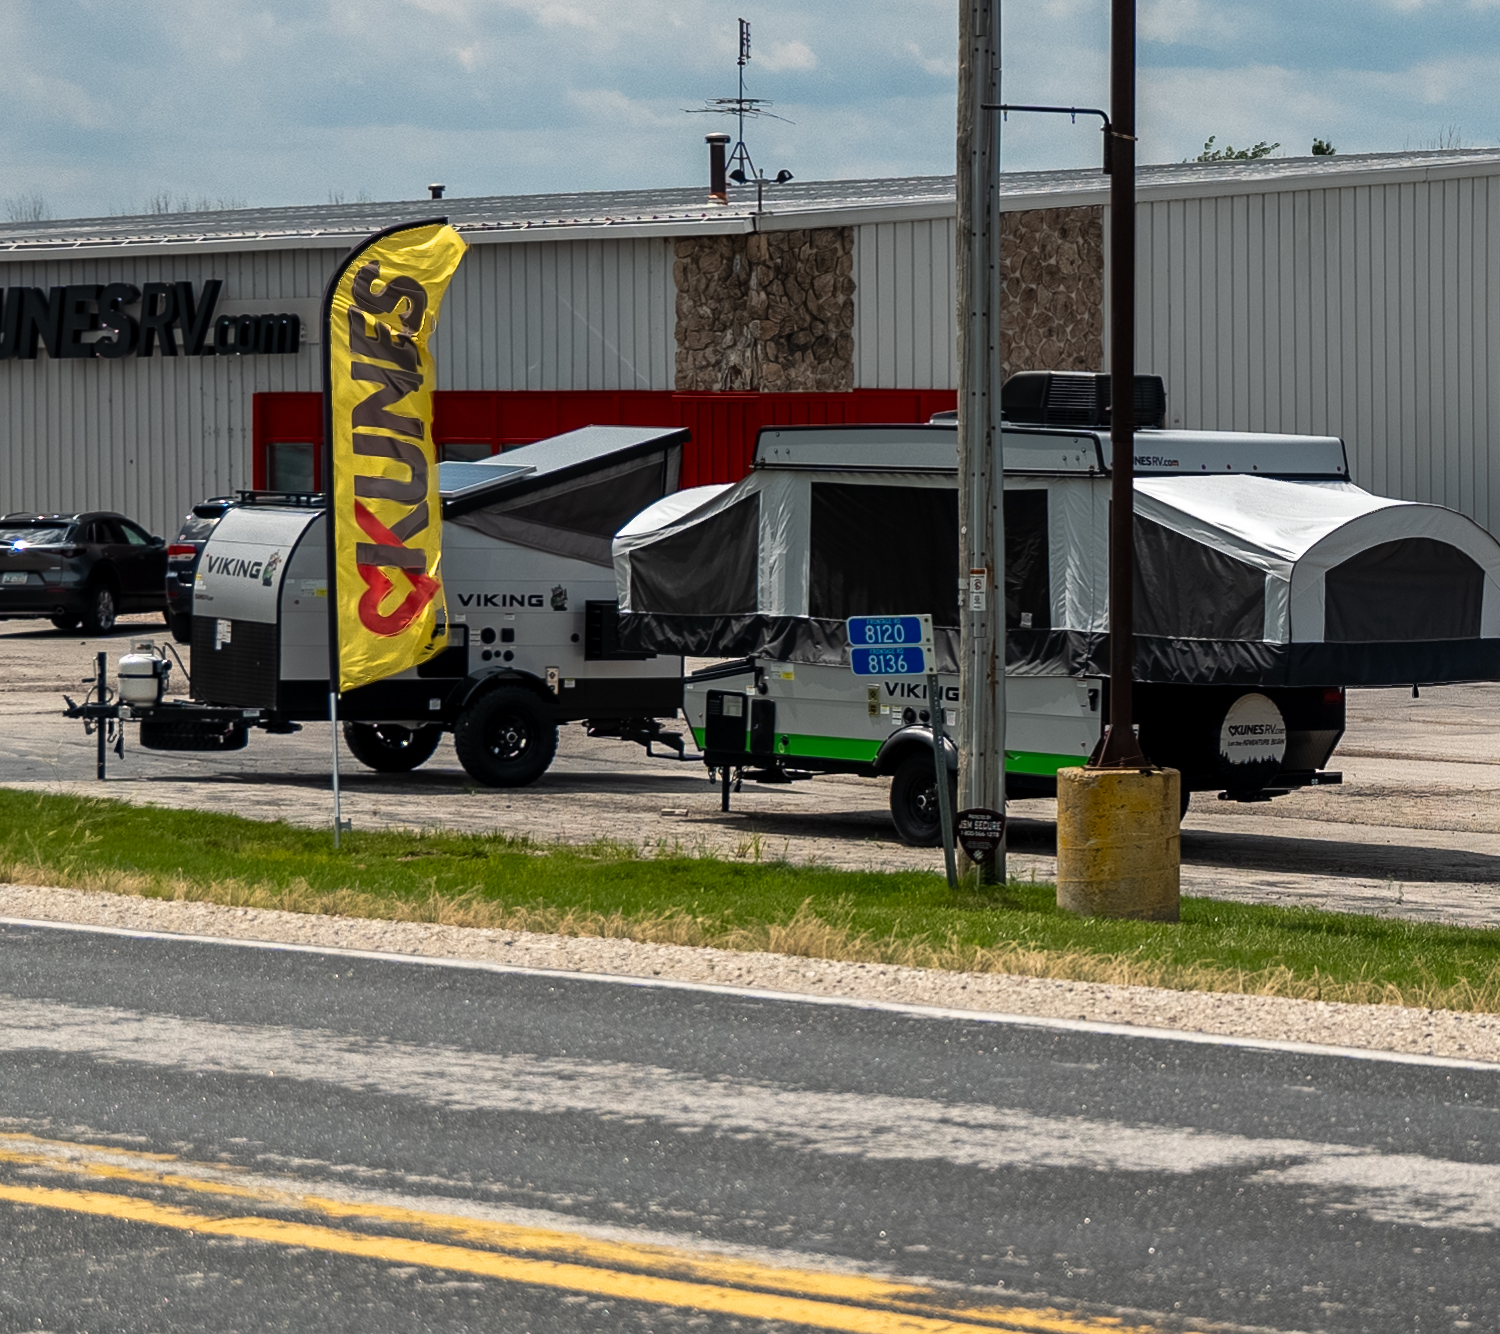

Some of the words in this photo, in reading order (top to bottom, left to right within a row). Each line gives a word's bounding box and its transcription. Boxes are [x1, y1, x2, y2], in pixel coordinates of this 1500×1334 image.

[347, 259, 430, 575] KUNES
[207, 555, 263, 579] VIKING
[457, 593, 544, 607] VIKING
[865, 624, 905, 643] 8120
[868, 654, 908, 673] 8136
[884, 681, 960, 702] VIKIG
[974, 820, 1002, 831] SECURE
